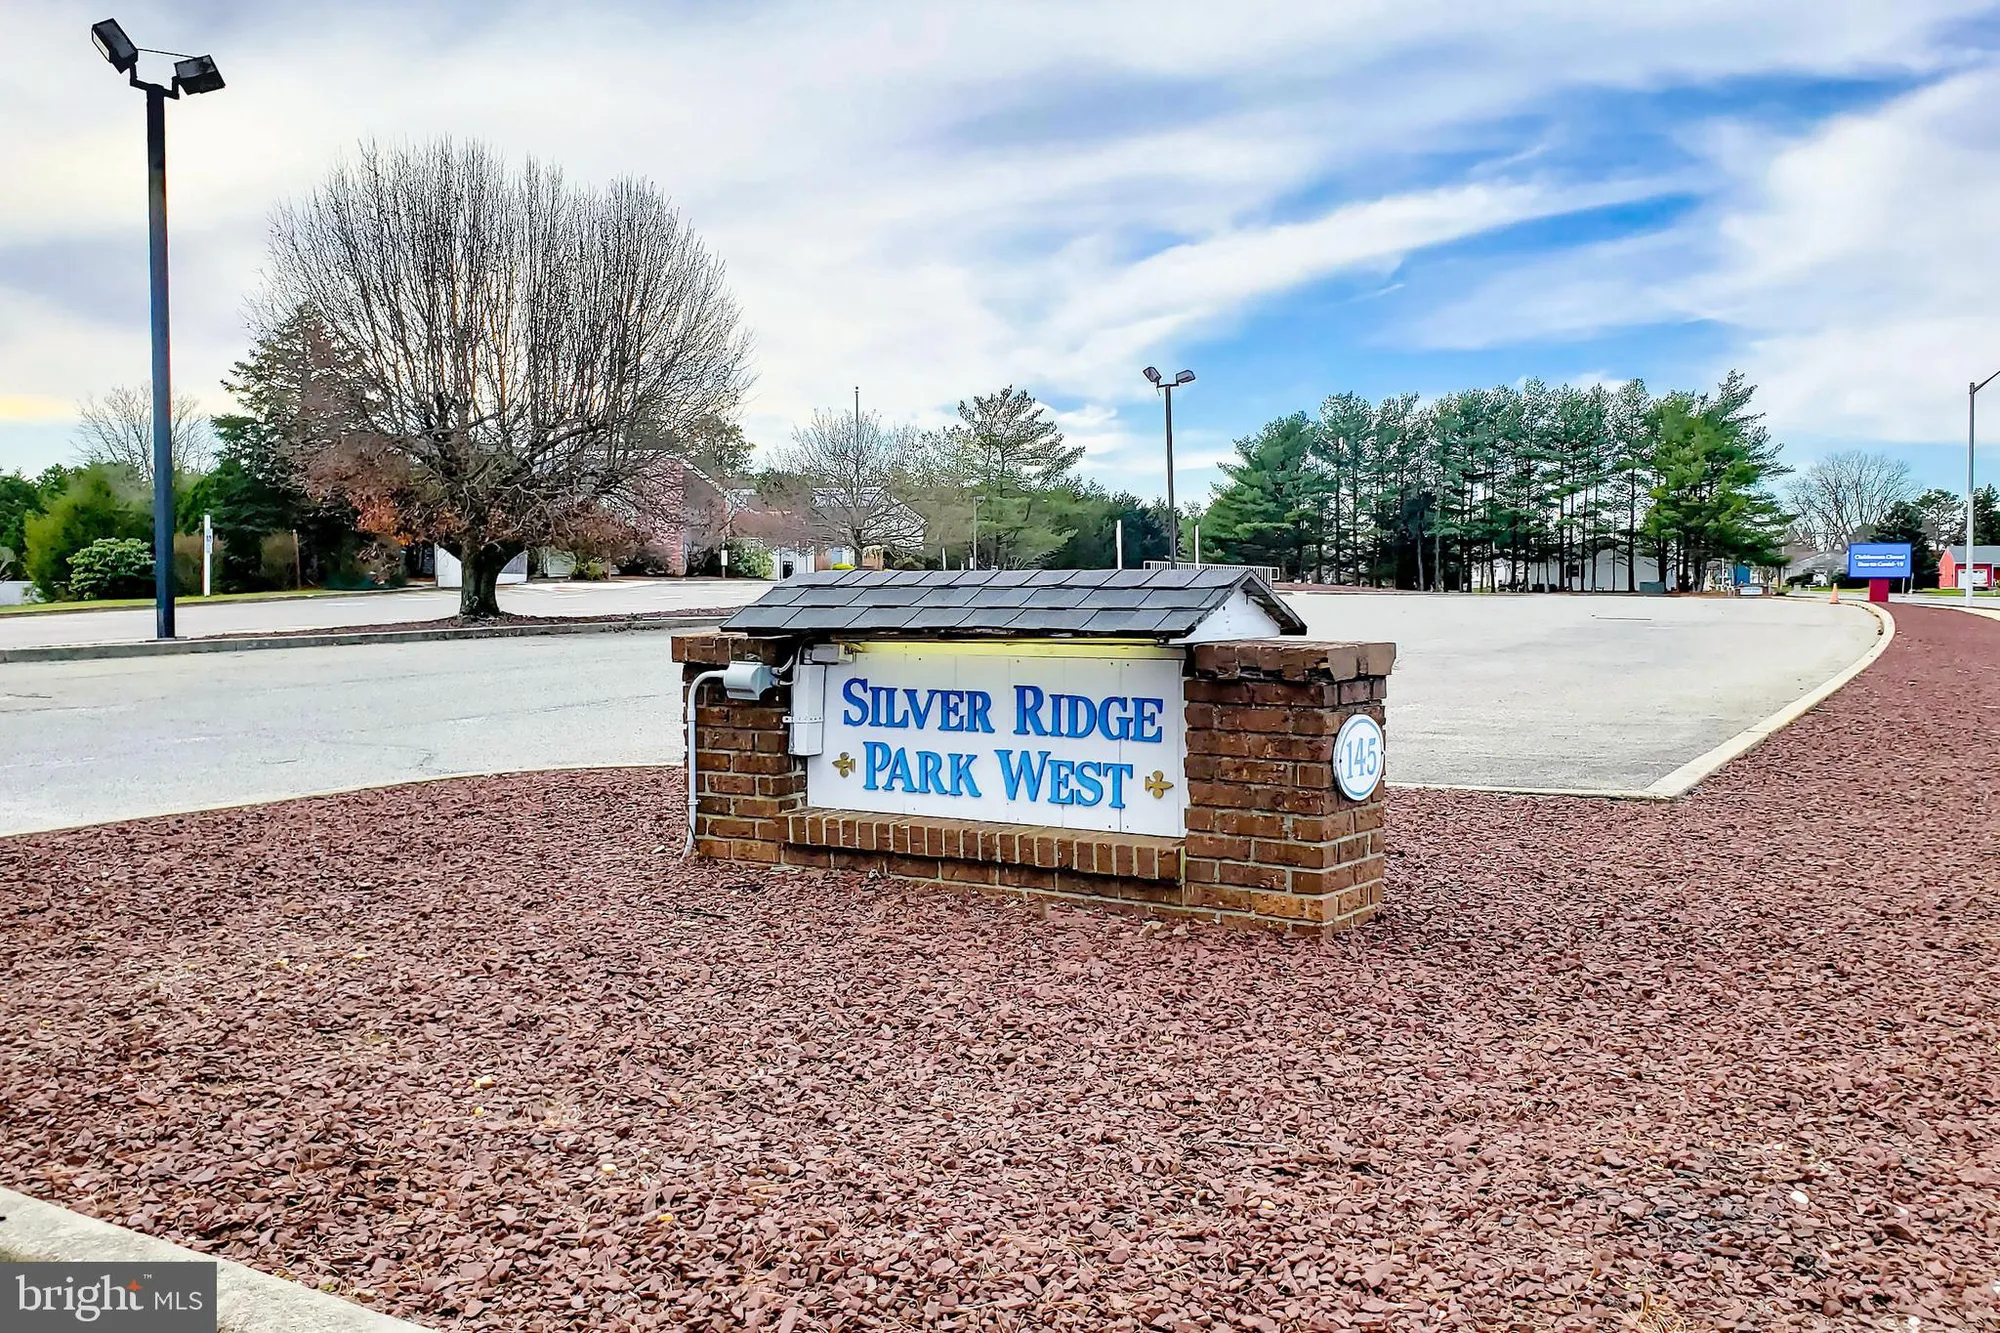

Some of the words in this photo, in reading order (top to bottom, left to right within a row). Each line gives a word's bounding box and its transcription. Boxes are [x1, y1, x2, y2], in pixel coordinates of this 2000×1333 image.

[842, 677, 995, 733] SILVER
[1013, 684, 1164, 743] RIDGE
[863, 741, 982, 798] PARK
[994, 749, 1133, 809] WEST
[1345, 737, 1377, 779] 145
